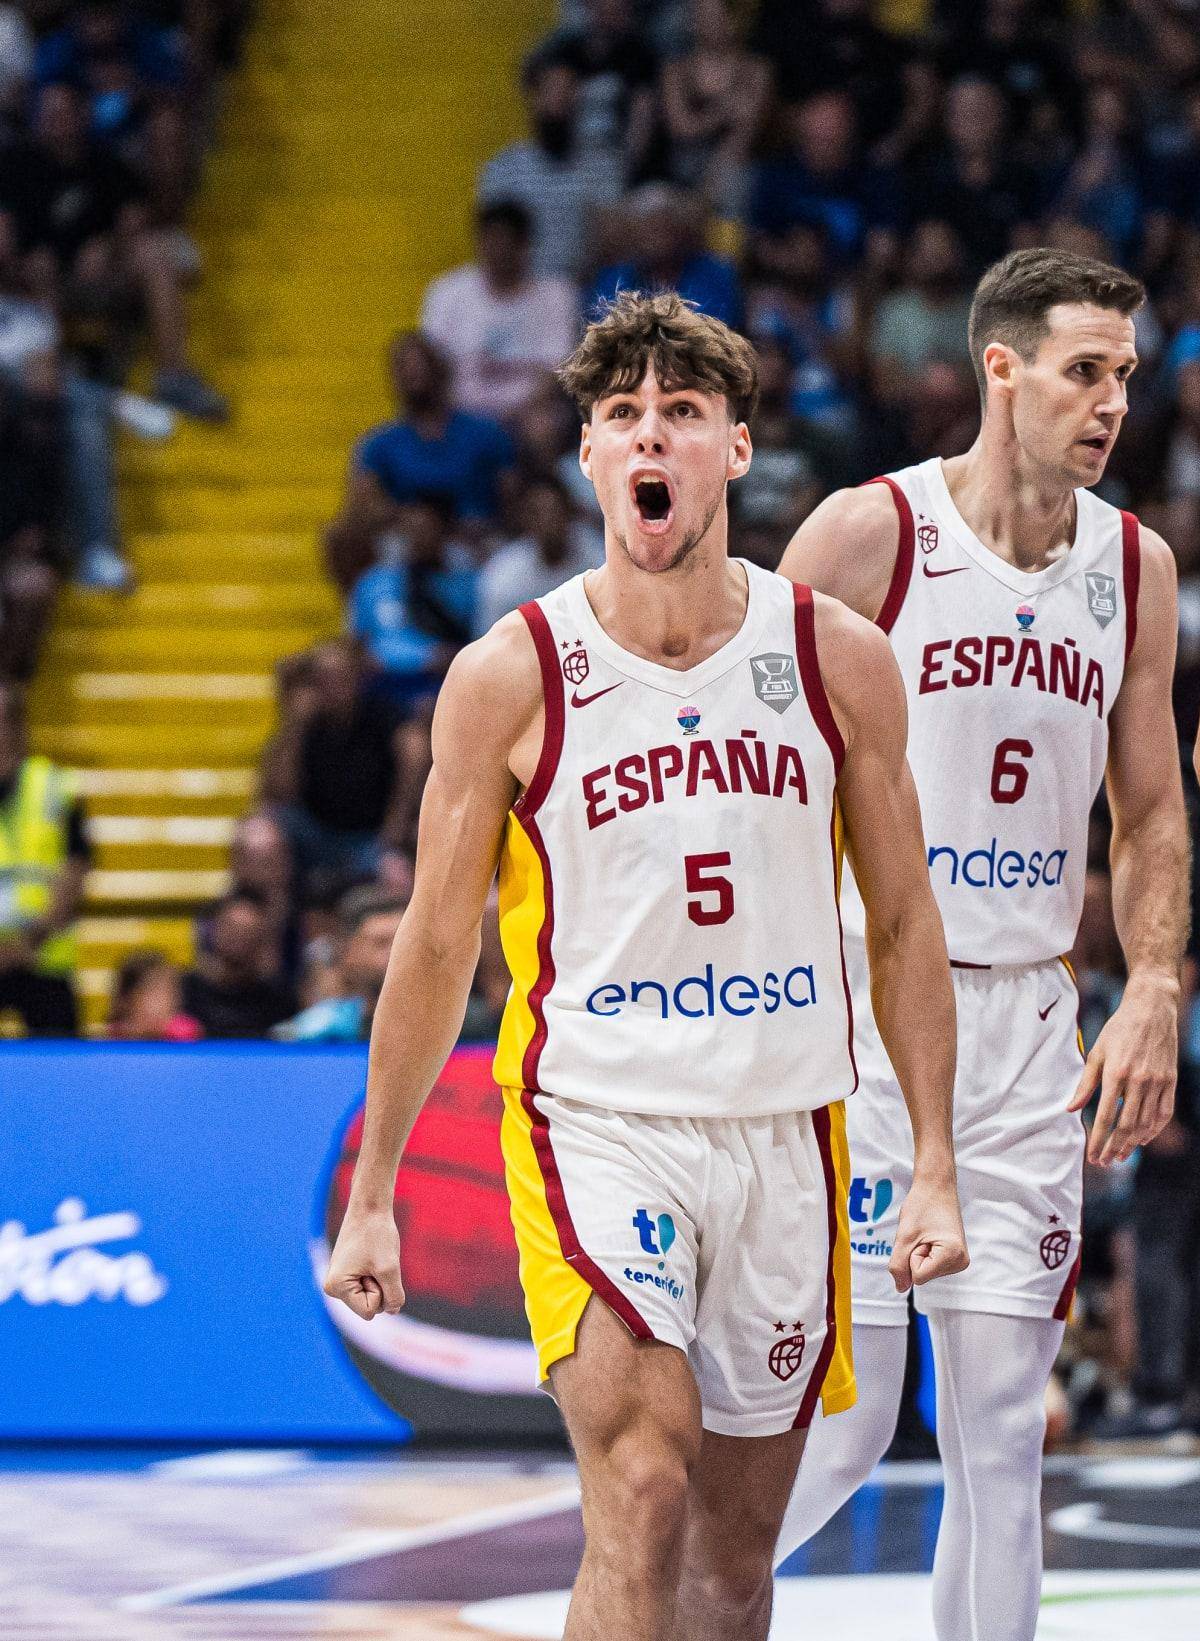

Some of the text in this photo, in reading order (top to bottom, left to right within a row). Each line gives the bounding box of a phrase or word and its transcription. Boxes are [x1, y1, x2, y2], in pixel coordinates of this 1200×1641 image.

[919, 636, 1104, 719] ESPAÑA
[582, 729, 808, 830] ESPAÑA
[990, 737, 1034, 805] 6
[684, 851, 735, 927] 5
[928, 837, 1068, 889] ndesa
[586, 963, 817, 1019] endesa
